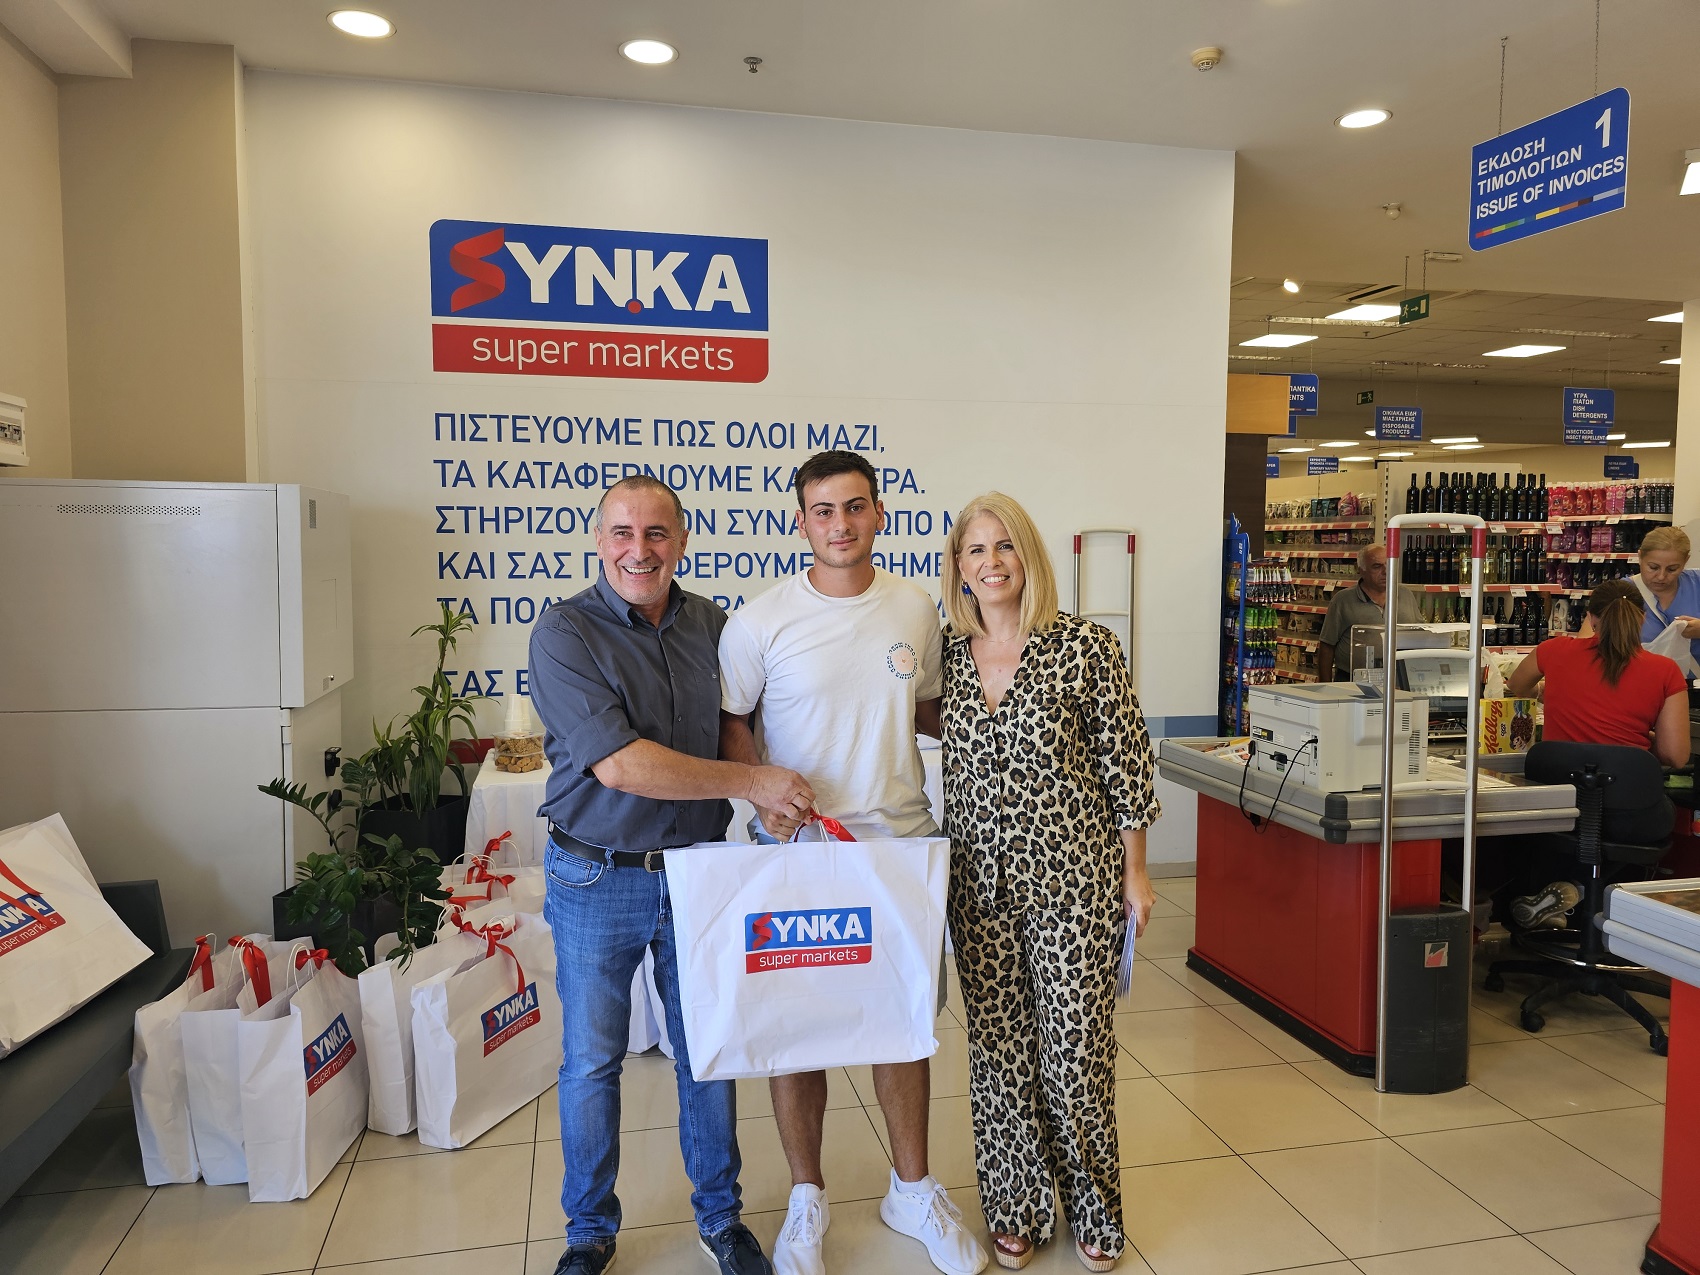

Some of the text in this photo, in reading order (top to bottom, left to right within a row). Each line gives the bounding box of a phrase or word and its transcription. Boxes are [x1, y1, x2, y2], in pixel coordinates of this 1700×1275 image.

[1595, 108, 1612, 148] 1
[1478, 137, 1545, 176] ΕΚΔΟΣΗ
[1478, 145, 1582, 196] ΤΙΜΟΛΟΓΙΩΝ
[1476, 156, 1625, 220] ISSUE OF INVOICES
[450, 228, 751, 314] SYNKA
[472, 338, 734, 371] super markets
[435, 412, 885, 453] ΠΙΣΤΕΥΟΥΜΕ ΠΩΣ ΟΛΟΙ ΜΑΖΙ,
[433, 460, 476, 489] ΤΑ
[438, 552, 495, 580] ΚΑΙ
[508, 552, 572, 579] ΣΑΣ
[752, 912, 865, 950] SYNKA
[759, 949, 859, 968] super markets
[486, 989, 534, 1037] SYNKA
[489, 1015, 533, 1050] super markets
[306, 1020, 348, 1076] SYNKA
[314, 1046, 352, 1088] super markets
